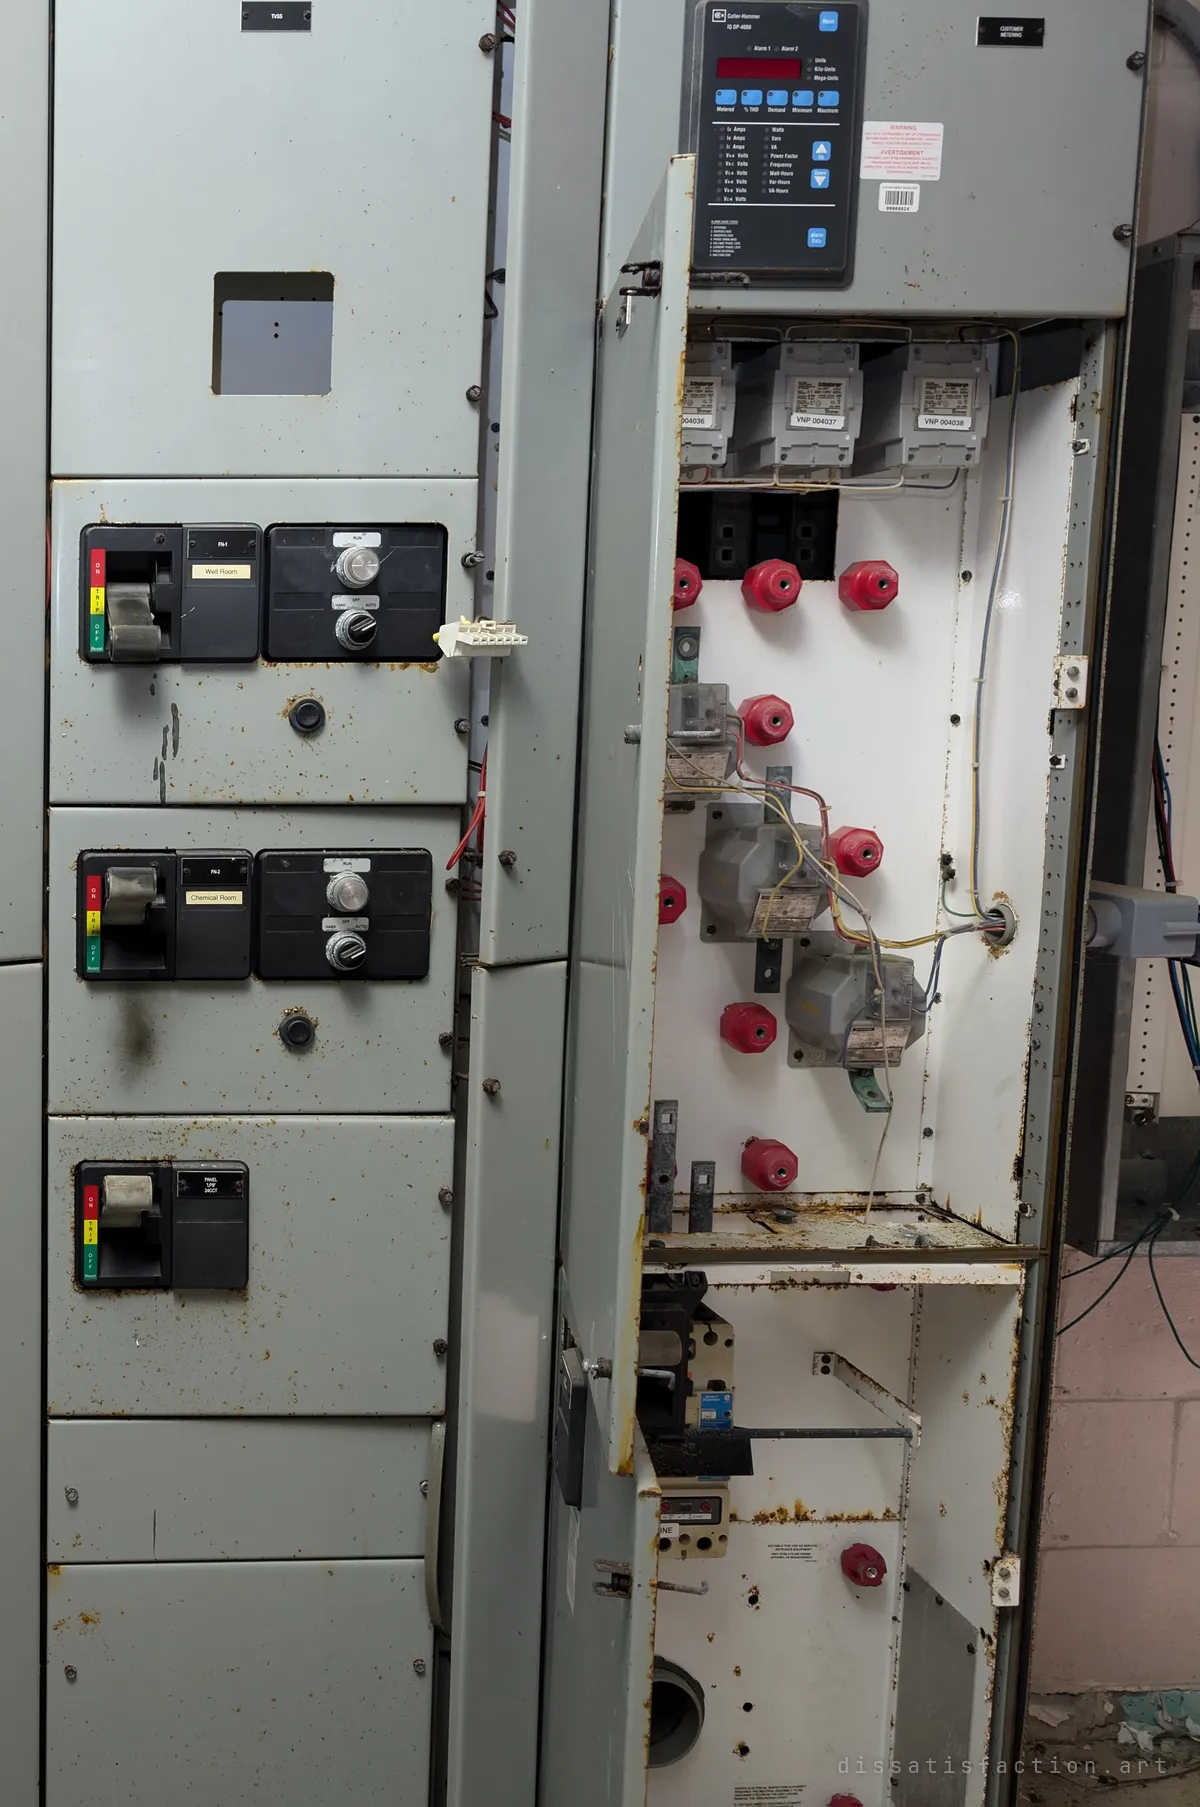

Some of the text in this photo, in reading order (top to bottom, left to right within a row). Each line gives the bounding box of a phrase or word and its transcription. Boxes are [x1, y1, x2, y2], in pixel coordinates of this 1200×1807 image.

[796, 416, 811, 424] VNP
[940, 418, 964, 426] 004038
[95, 563, 100, 575] ON
[91, 887, 96, 899] ON
[88, 1197, 94, 1208] ON
